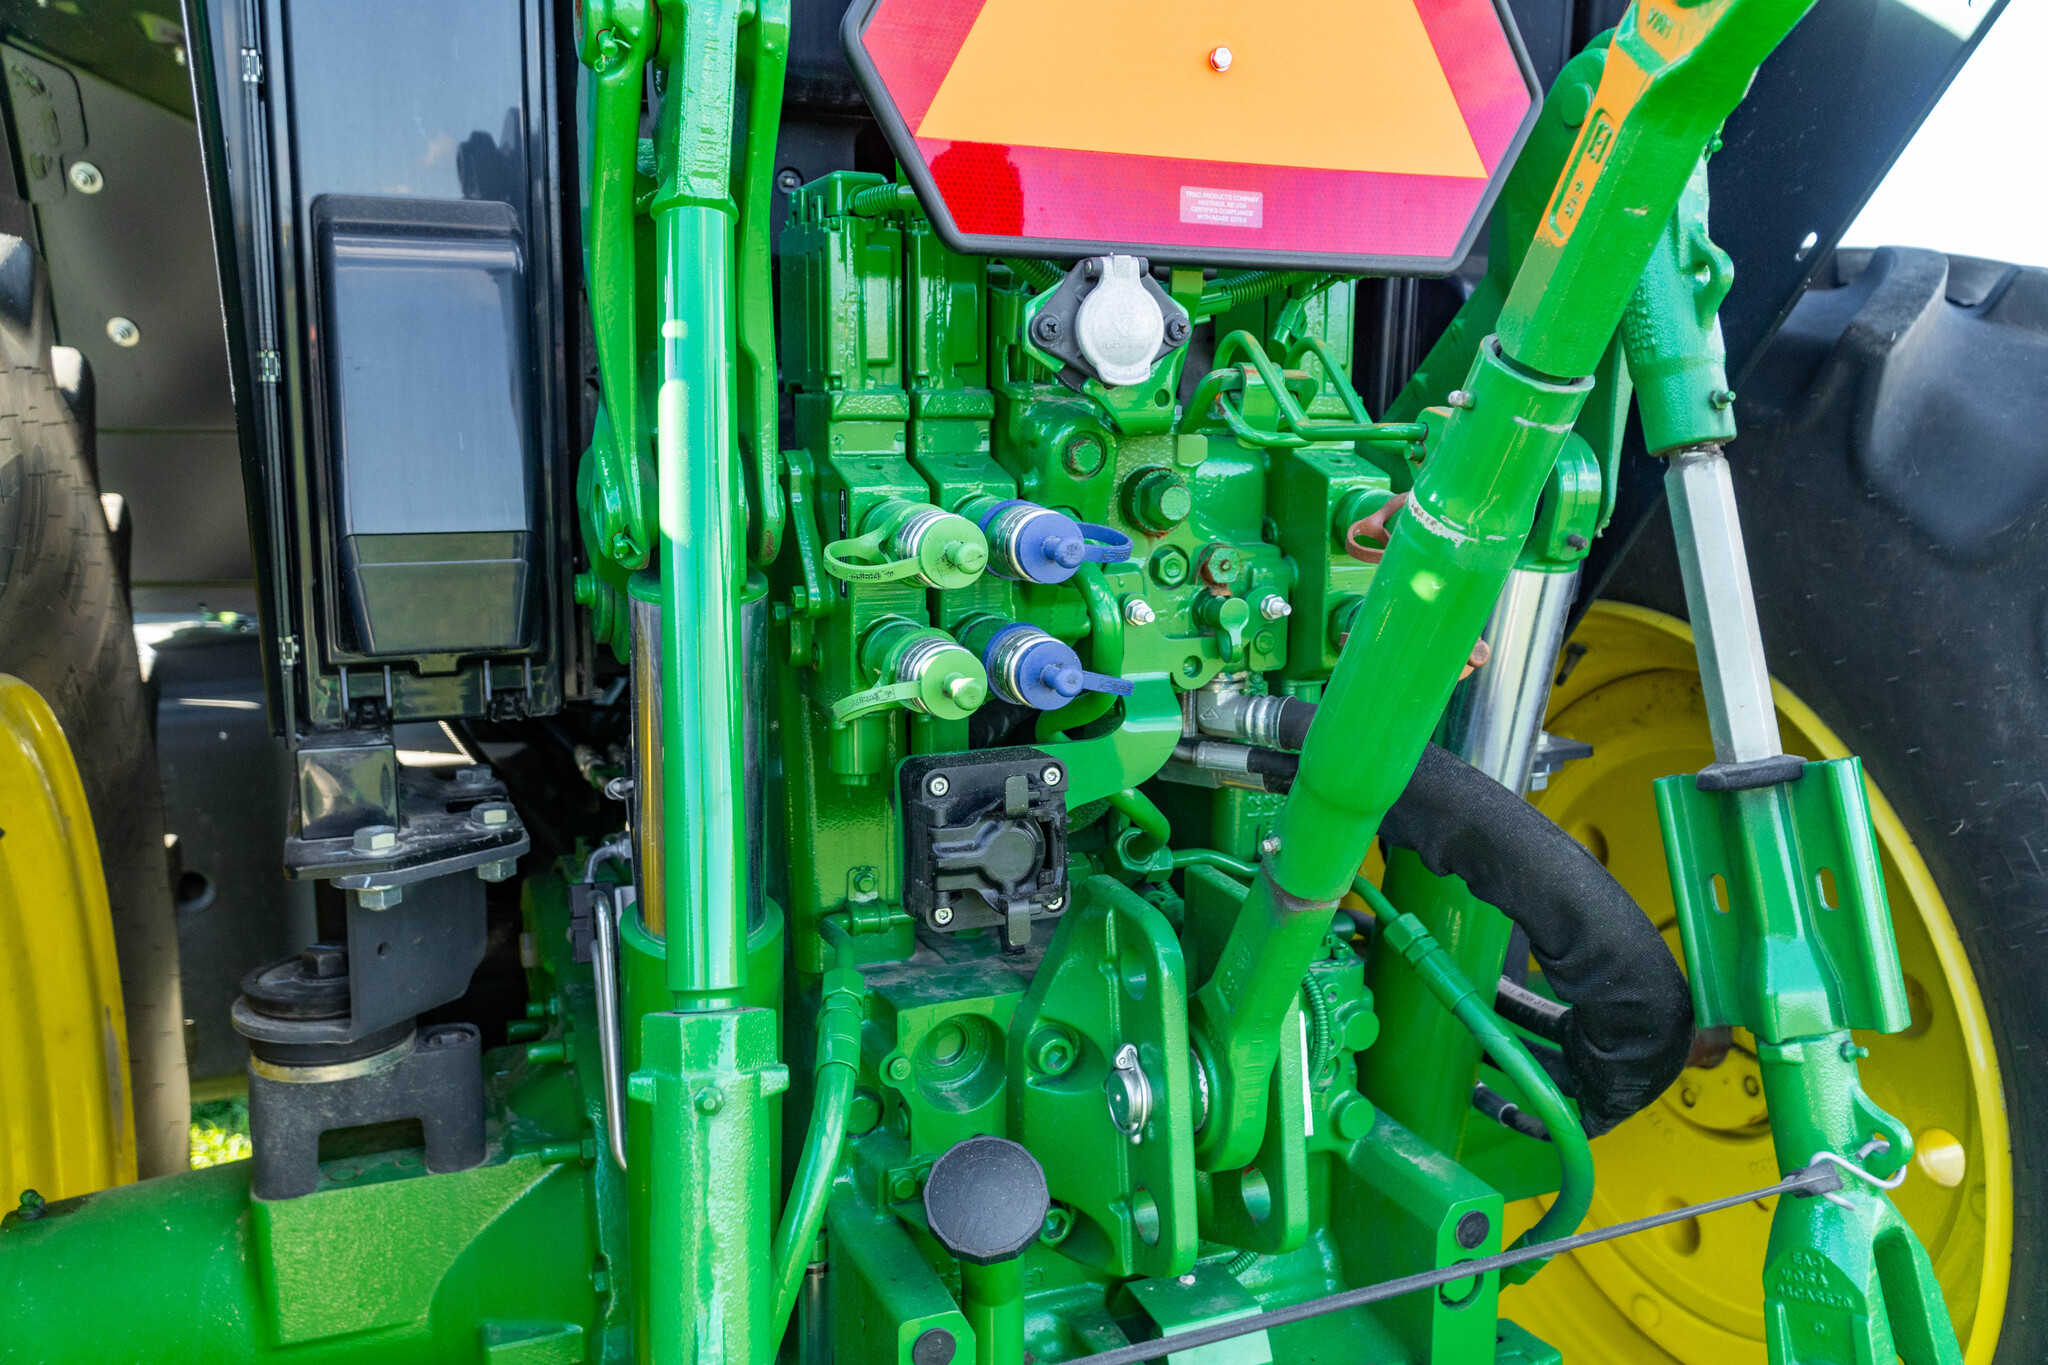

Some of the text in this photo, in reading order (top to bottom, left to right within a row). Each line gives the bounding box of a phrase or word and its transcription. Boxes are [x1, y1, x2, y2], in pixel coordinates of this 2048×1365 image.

[1203, 192, 1232, 201] PRODUCTS
[1233, 195, 1260, 203] COMPANY
[1219, 208, 1254, 217] COMPLIANCE
